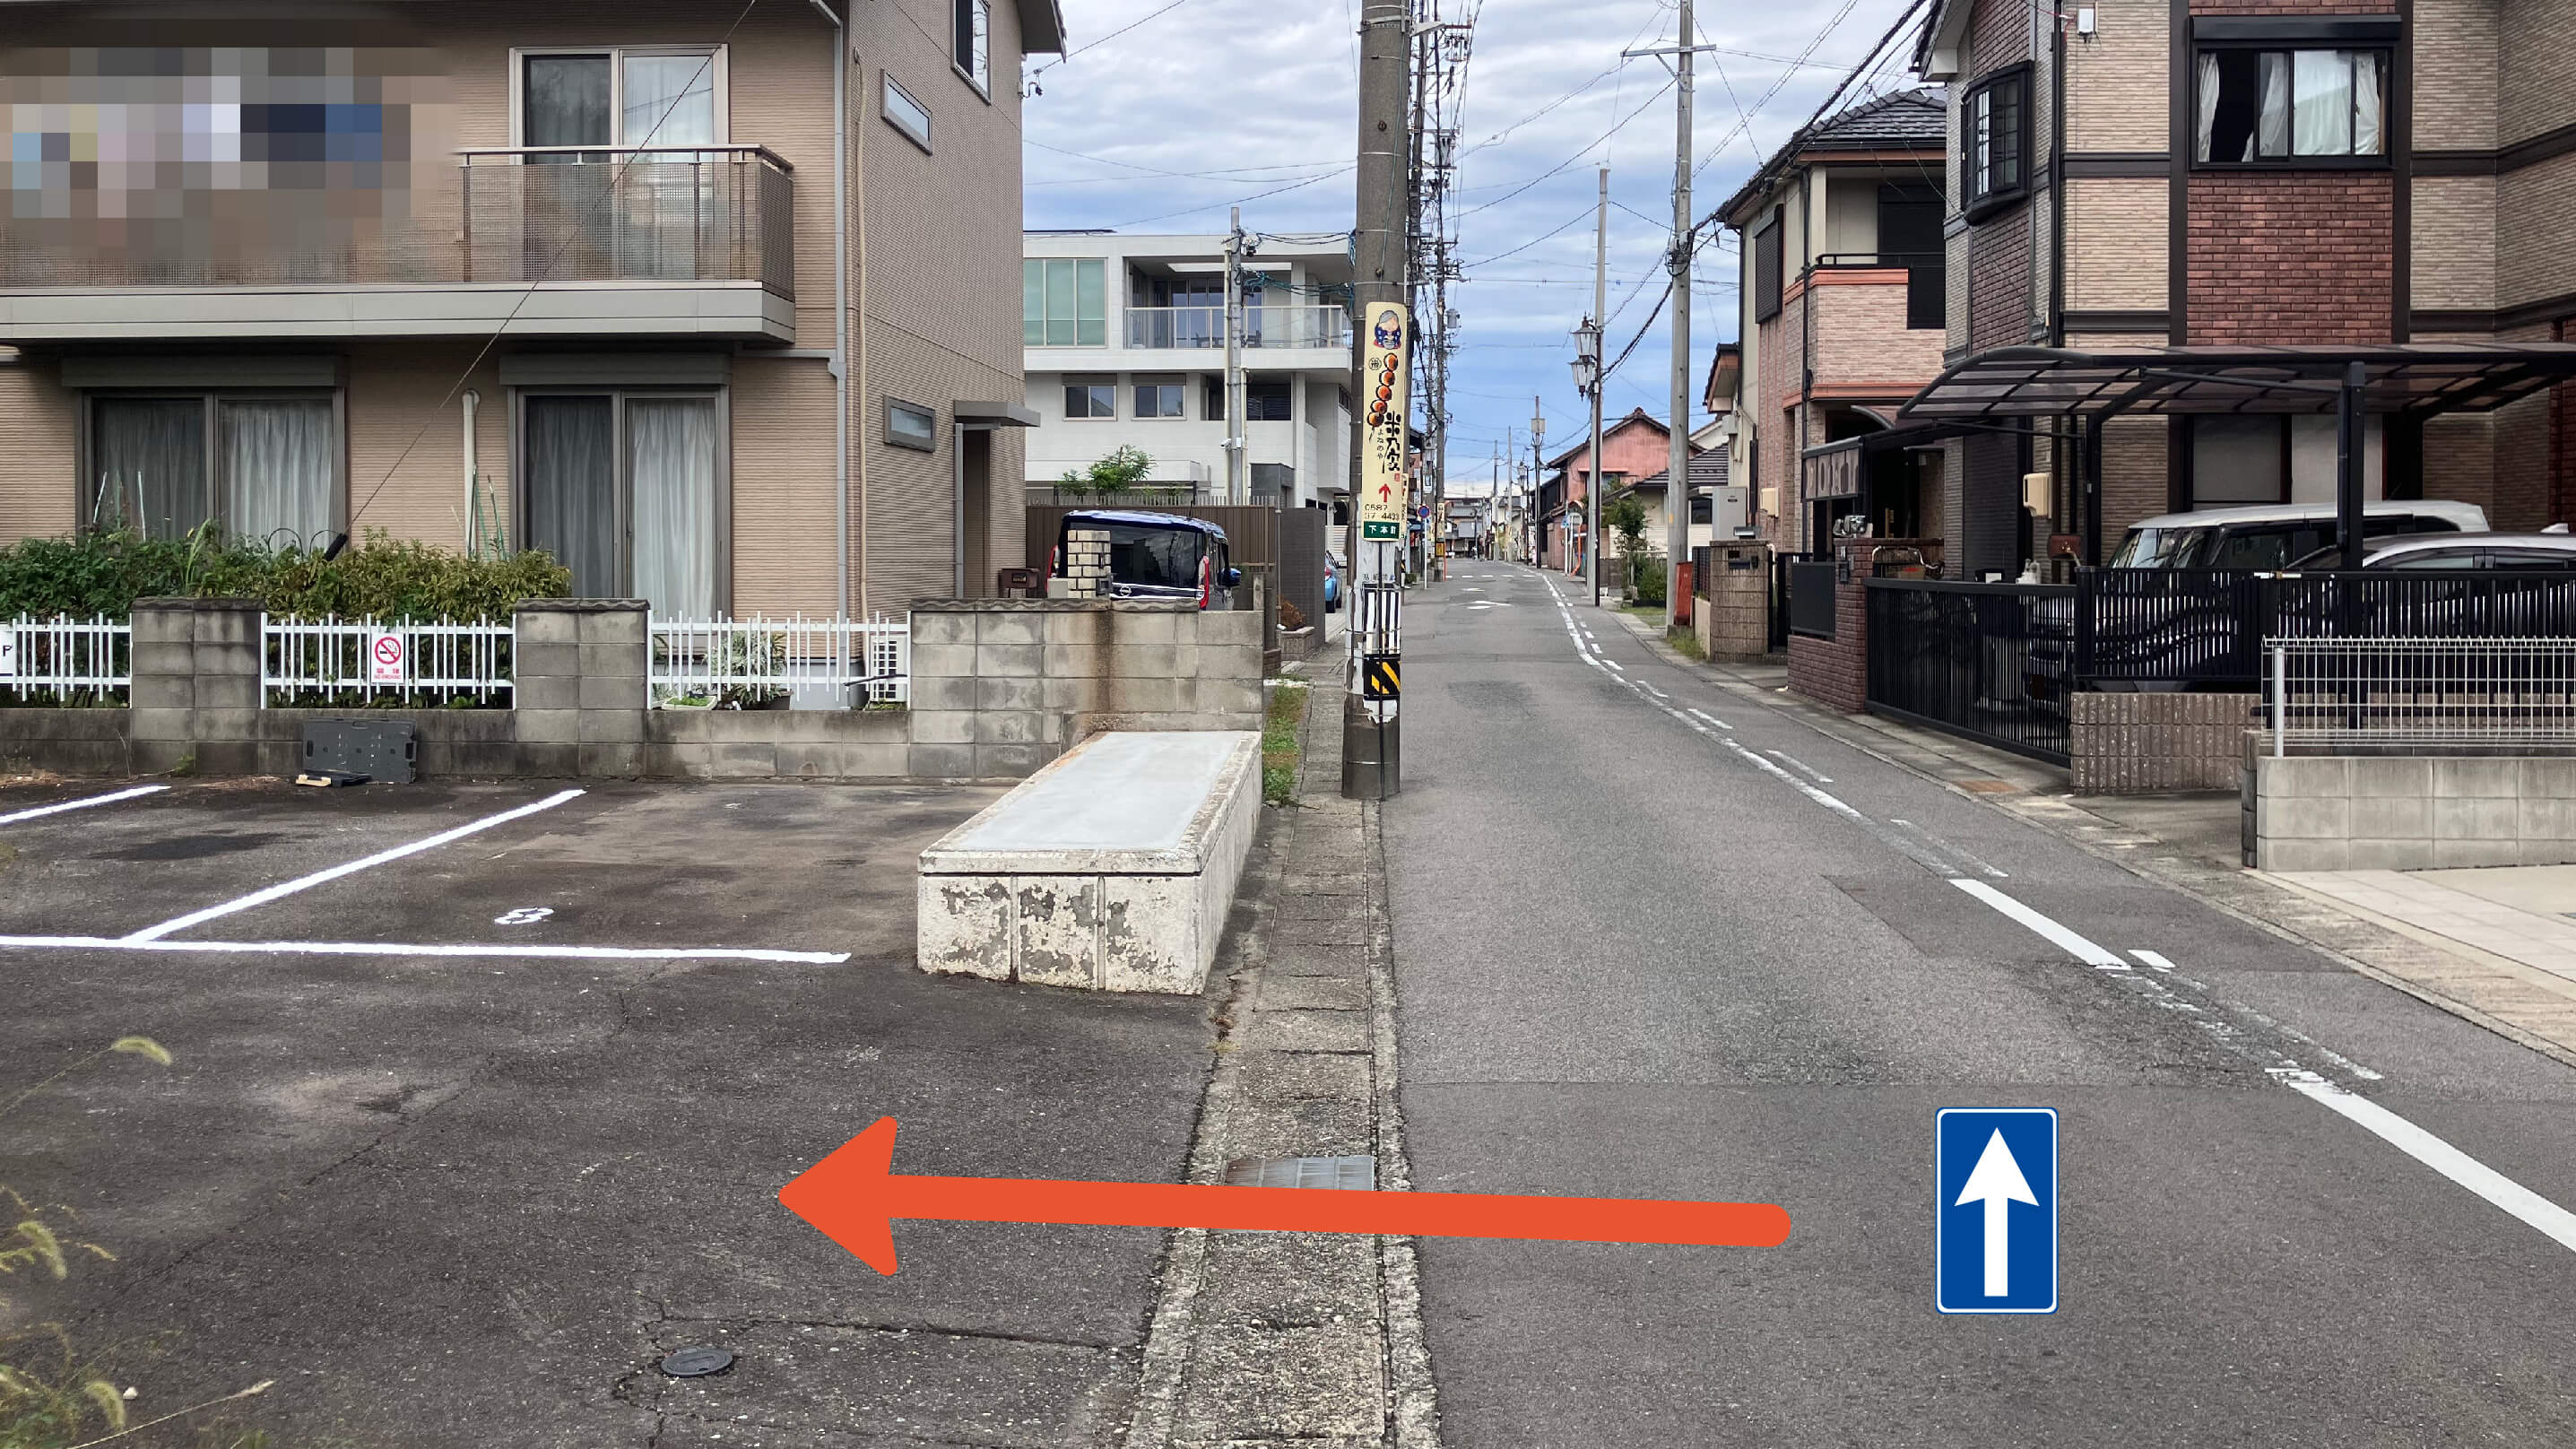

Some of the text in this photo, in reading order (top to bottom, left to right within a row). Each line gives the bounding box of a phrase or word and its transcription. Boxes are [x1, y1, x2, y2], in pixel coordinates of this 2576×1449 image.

[1376, 429, 1384, 460] よねのや
[1368, 525, 1397, 535] 下本町
